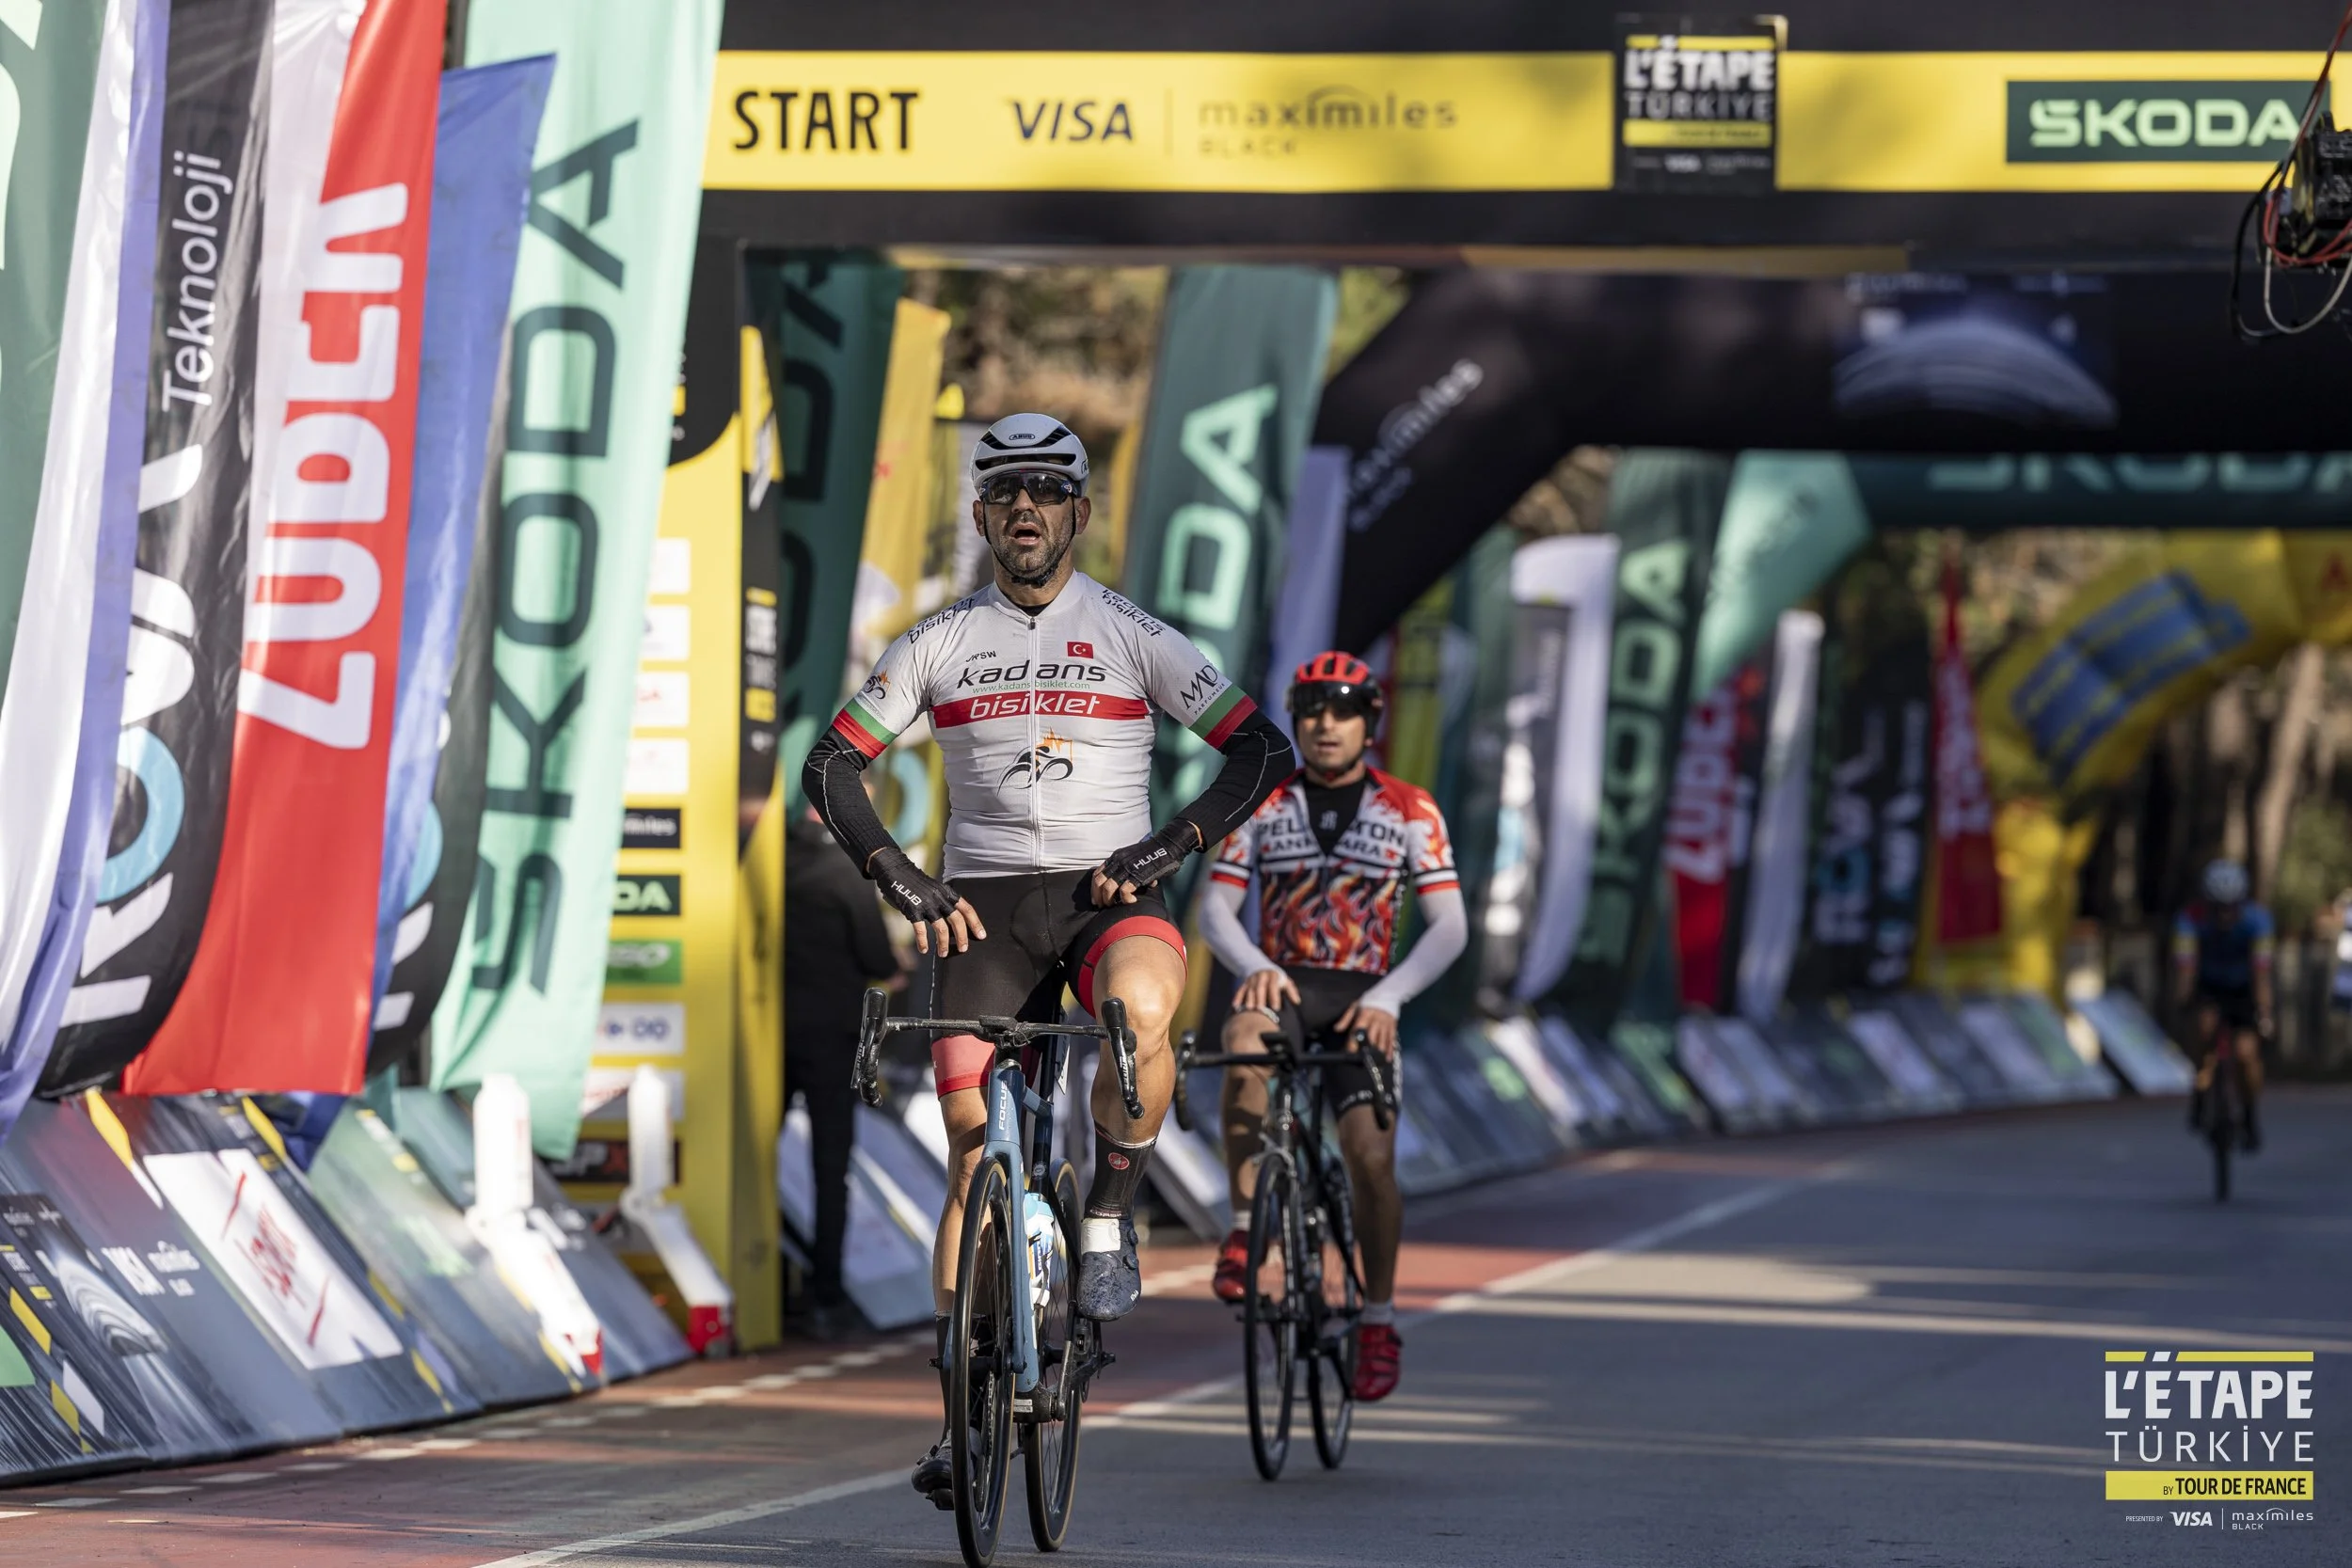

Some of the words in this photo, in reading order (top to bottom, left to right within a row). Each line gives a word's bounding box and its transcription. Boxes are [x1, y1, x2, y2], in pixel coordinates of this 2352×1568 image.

[734, 90, 920, 150] START
[1008, 101, 1135, 142] VISA
[1199, 85, 1458, 131] maximiles
[162, 150, 233, 412] Teknoloji
[1103, 594, 1162, 637] bisiklet
[957, 660, 1107, 689] kadans
[970, 693, 1101, 720] bisiklet
[1133, 847, 1168, 870] HUUB
[891, 880, 923, 906] HUUB
[998, 1081, 1008, 1130] FOCUS
